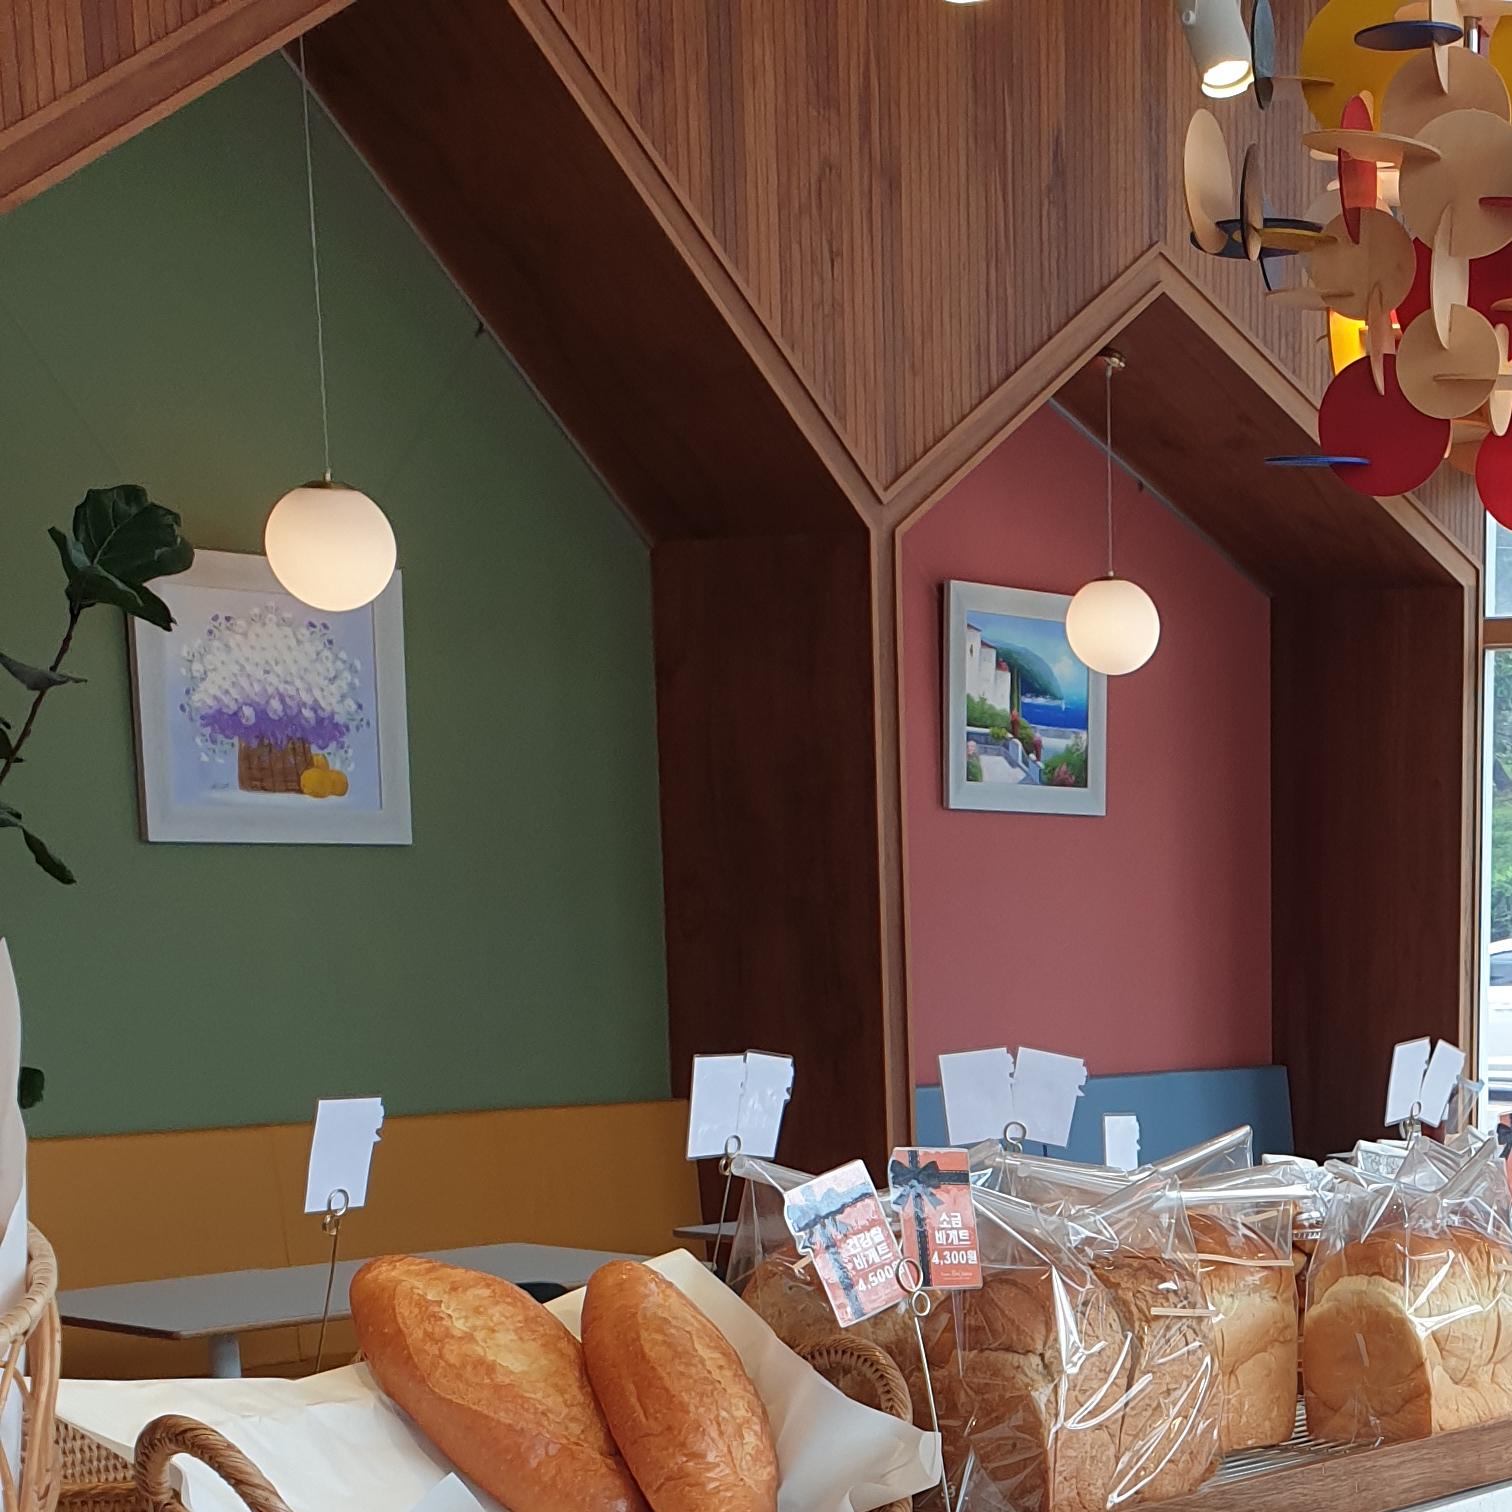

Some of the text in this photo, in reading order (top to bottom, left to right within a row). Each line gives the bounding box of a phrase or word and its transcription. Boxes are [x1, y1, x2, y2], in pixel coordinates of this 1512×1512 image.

[939, 1212, 962, 1228] 소금
[934, 1229, 971, 1246] 바게트
[852, 1244, 893, 1270] 바게트
[931, 1249, 978, 1265] 4,300원
